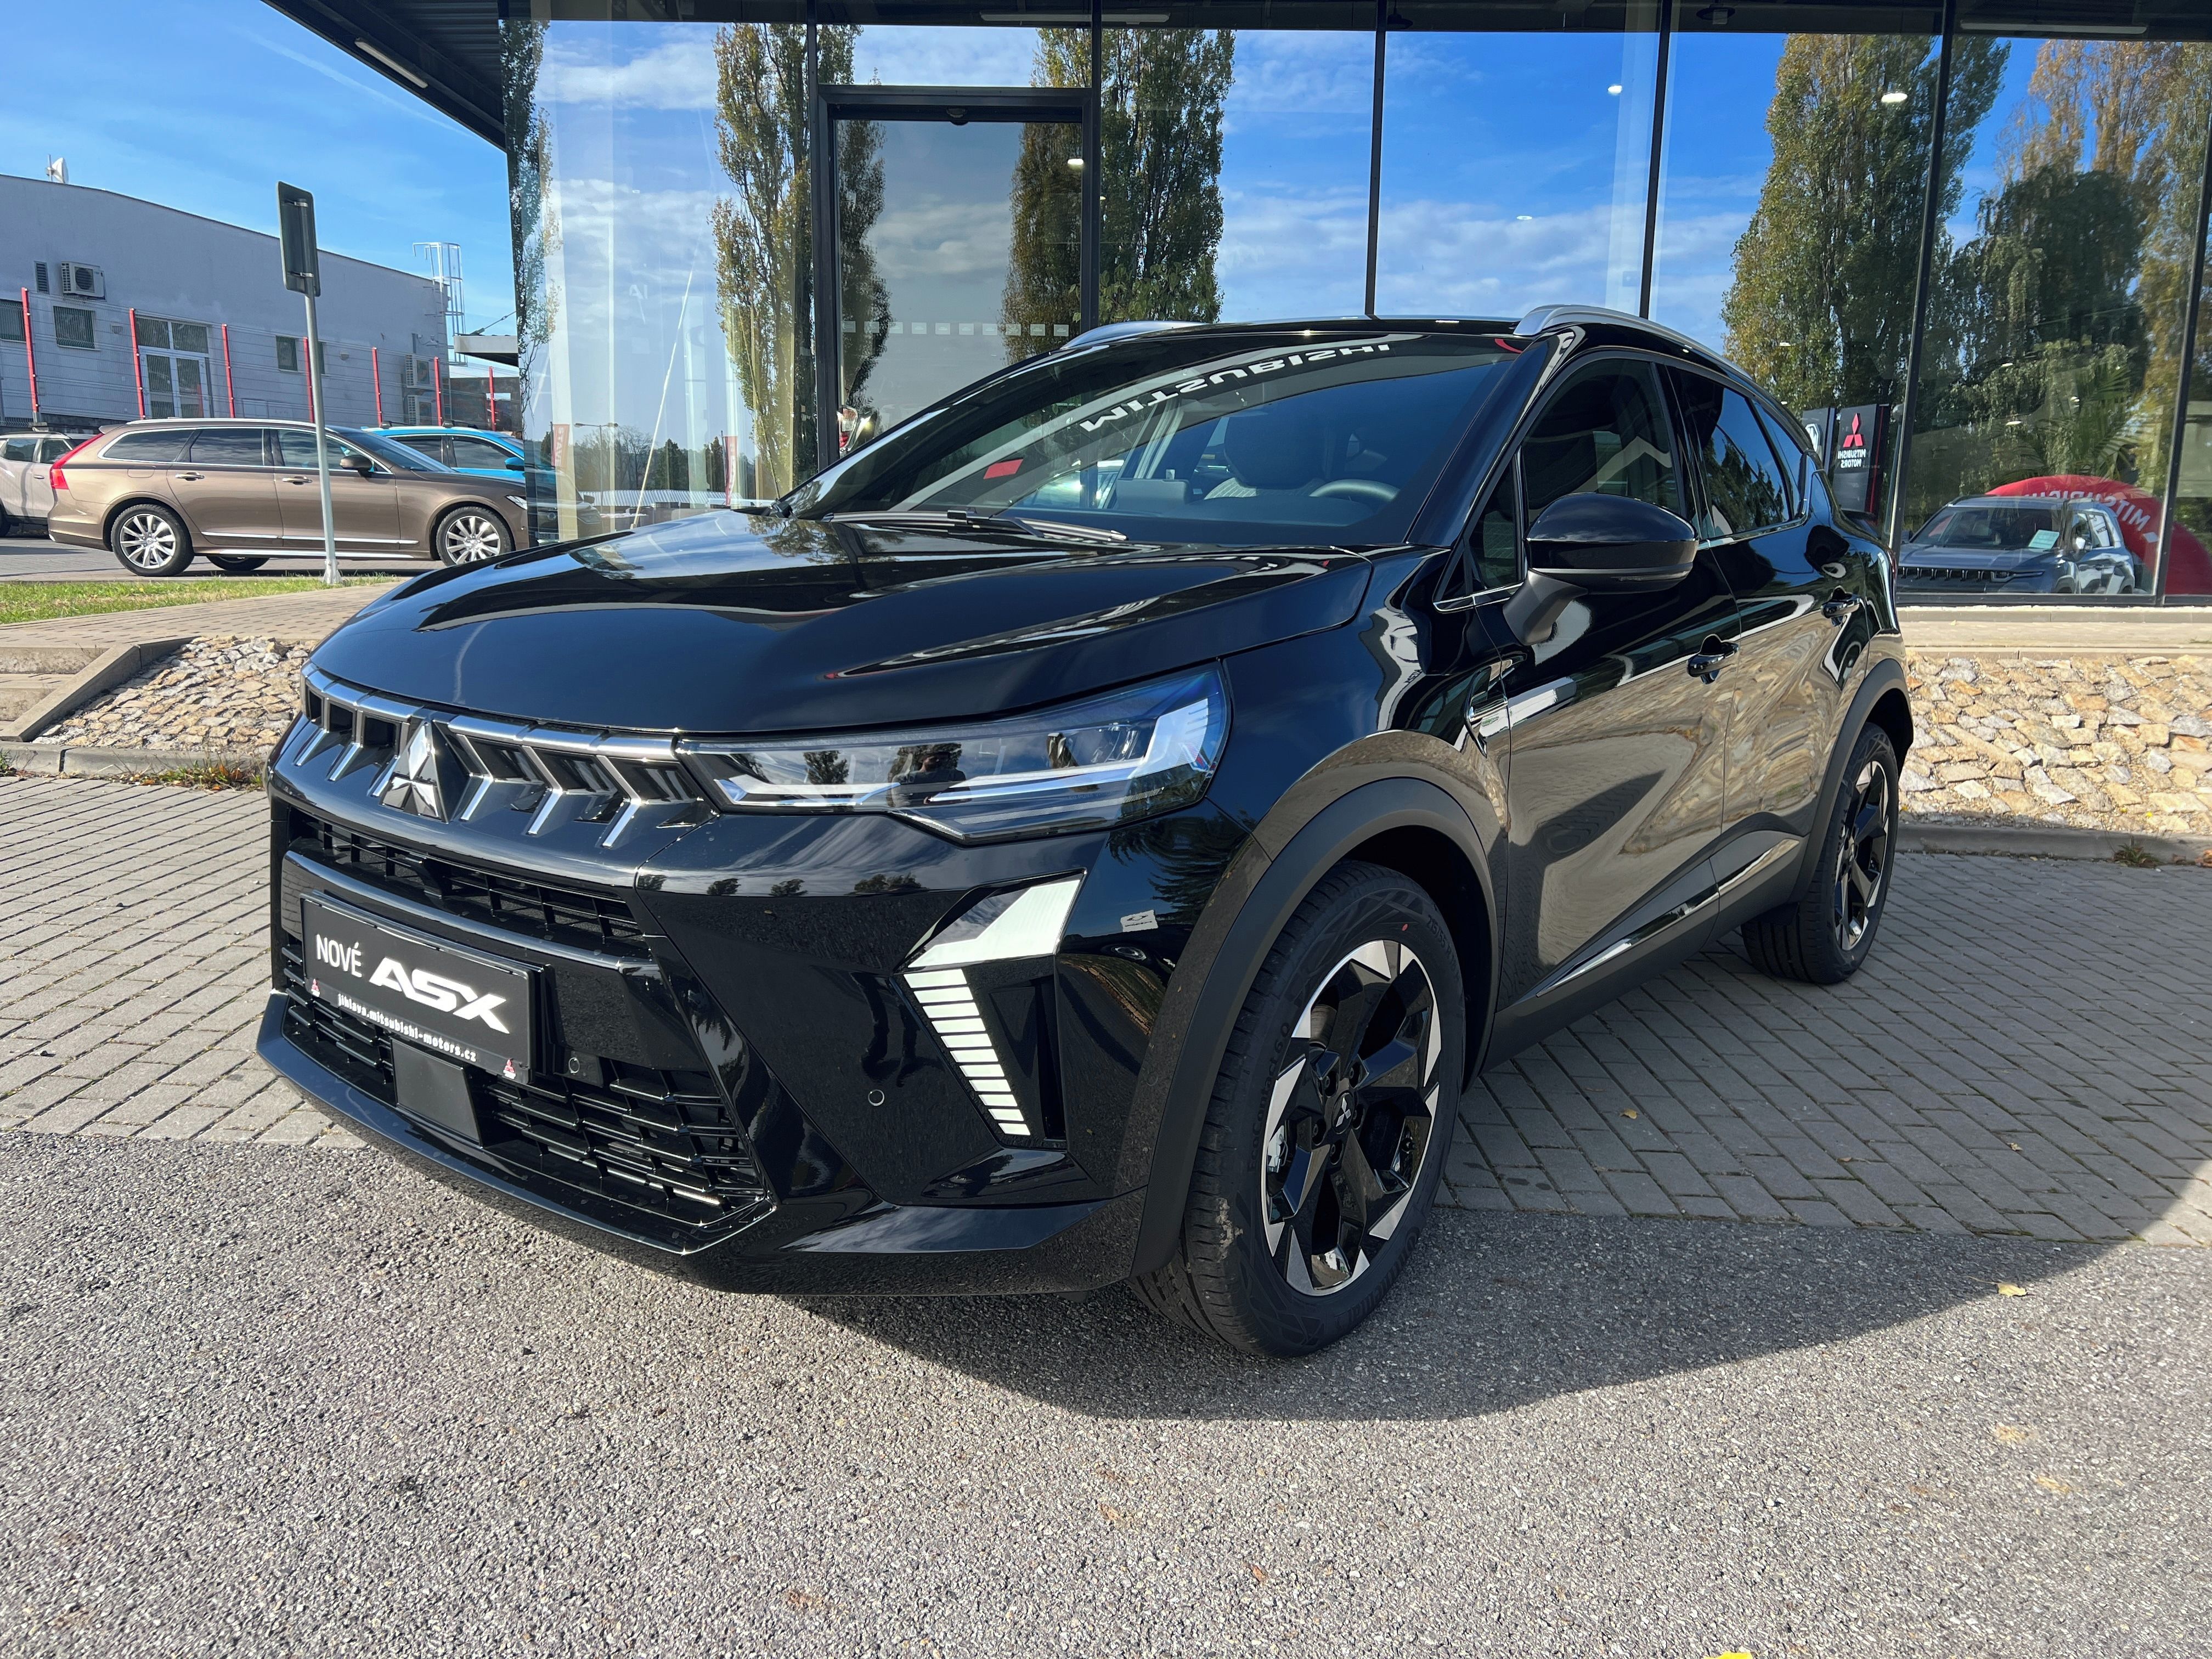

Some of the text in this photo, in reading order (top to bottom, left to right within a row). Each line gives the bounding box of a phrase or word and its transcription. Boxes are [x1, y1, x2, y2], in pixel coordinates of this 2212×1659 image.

[316, 934, 510, 1034] NOVÉ ASX
[338, 994, 477, 1062] jihlava.mitsubishi-motors.cz
